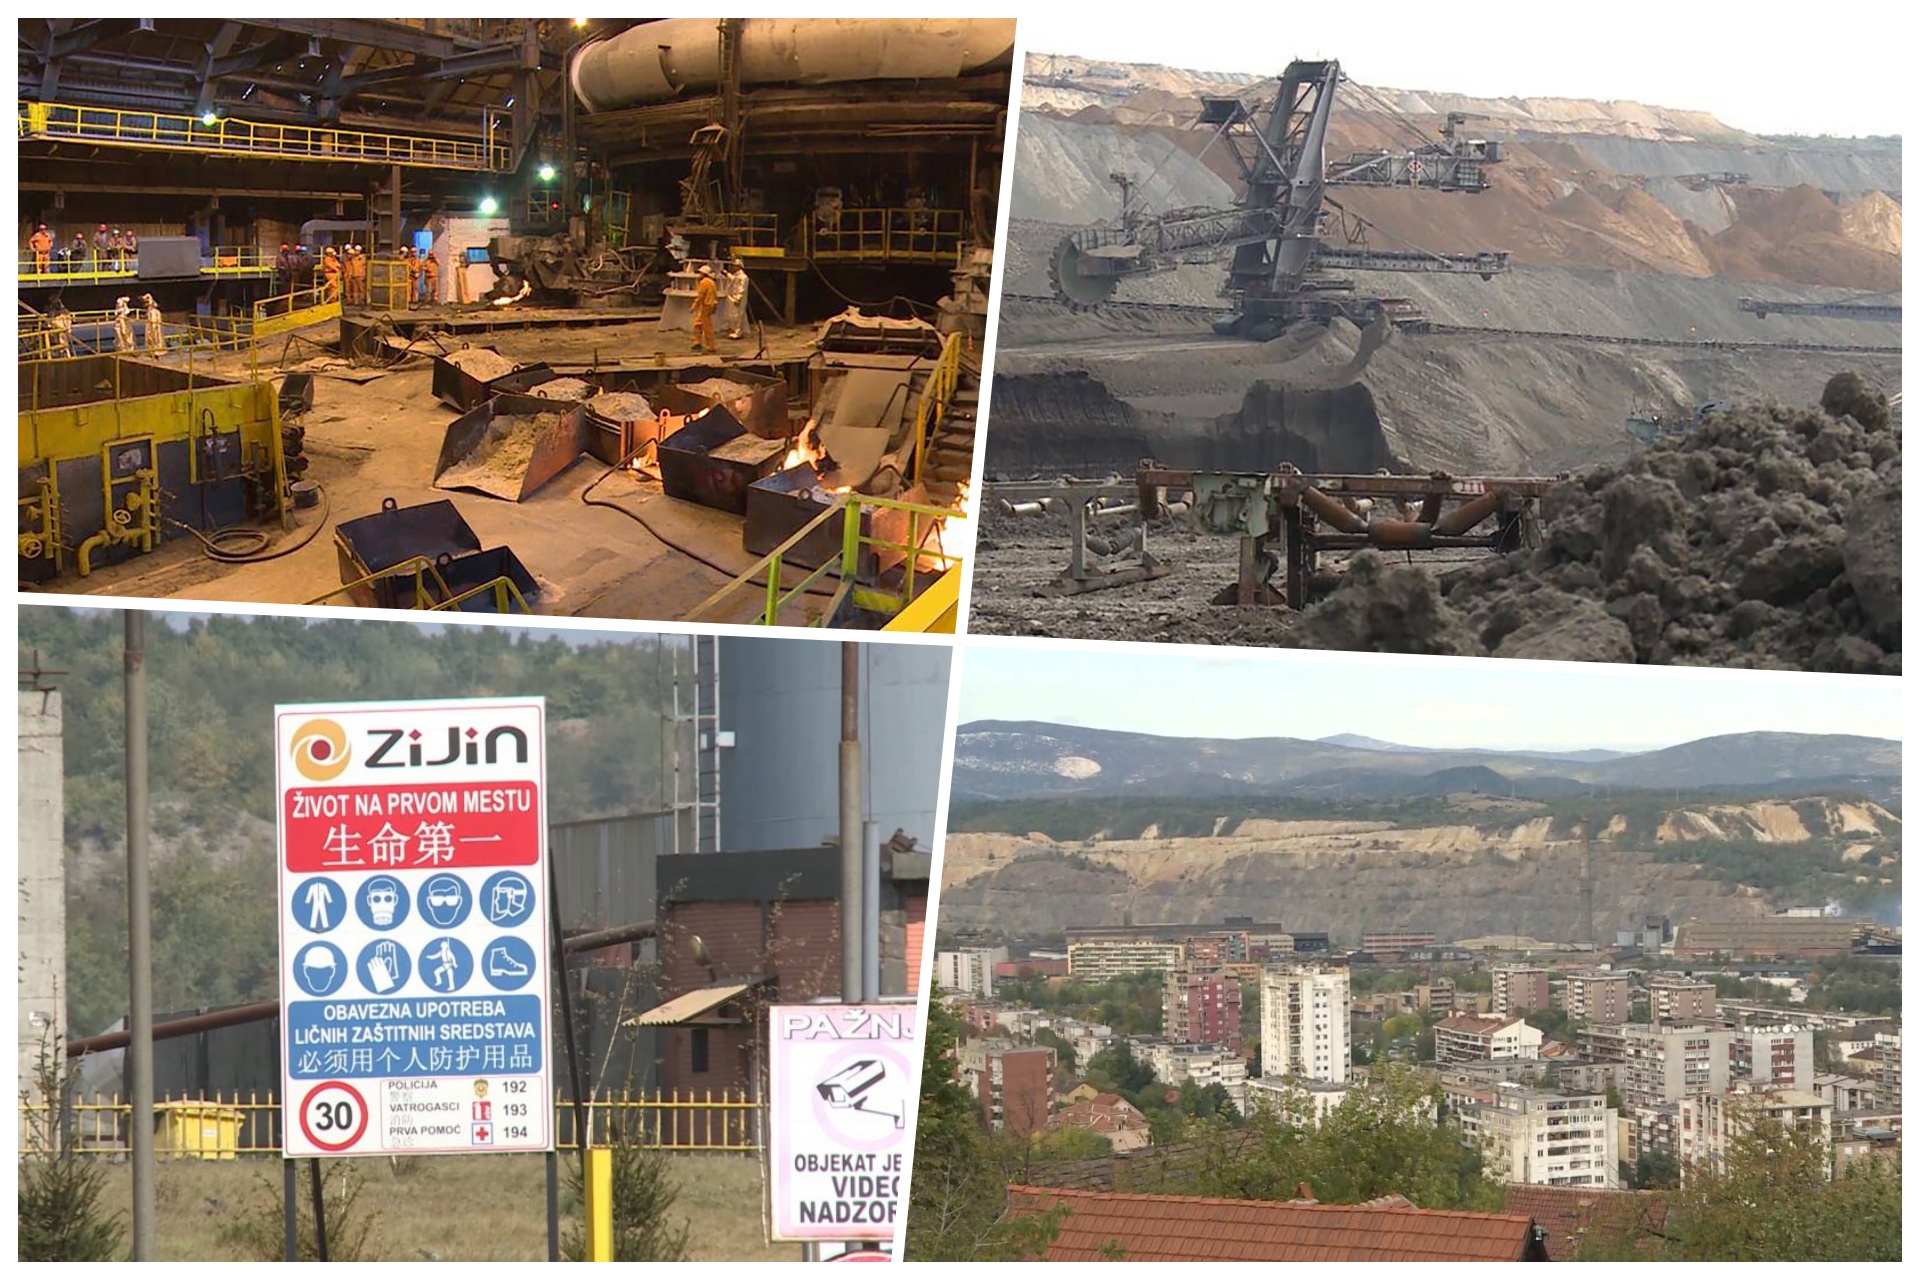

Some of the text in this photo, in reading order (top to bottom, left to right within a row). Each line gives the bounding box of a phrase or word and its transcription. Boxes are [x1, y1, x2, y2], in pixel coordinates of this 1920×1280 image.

[292, 789, 530, 818] ŽIVOT NA PRVOM MESTU
[322, 821, 503, 867] 生命第一
[324, 1000, 506, 1021] OBAVEZNA UPOTREBA
[295, 1022, 535, 1045] LIČNIH ZAŠTITNIH SREDSTAVA
[297, 1044, 532, 1074] 必须用个人防护用品
[388, 1080, 438, 1090] POLICIJA
[502, 1080, 527, 1093] 192
[315, 1101, 352, 1131] 30
[389, 1102, 460, 1112] VATROGASCI
[503, 1103, 527, 1116] 193
[389, 1126, 418, 1136] PRVA
[503, 1126, 527, 1138] 194
[794, 1153, 902, 1172] OBJEKAT JE
